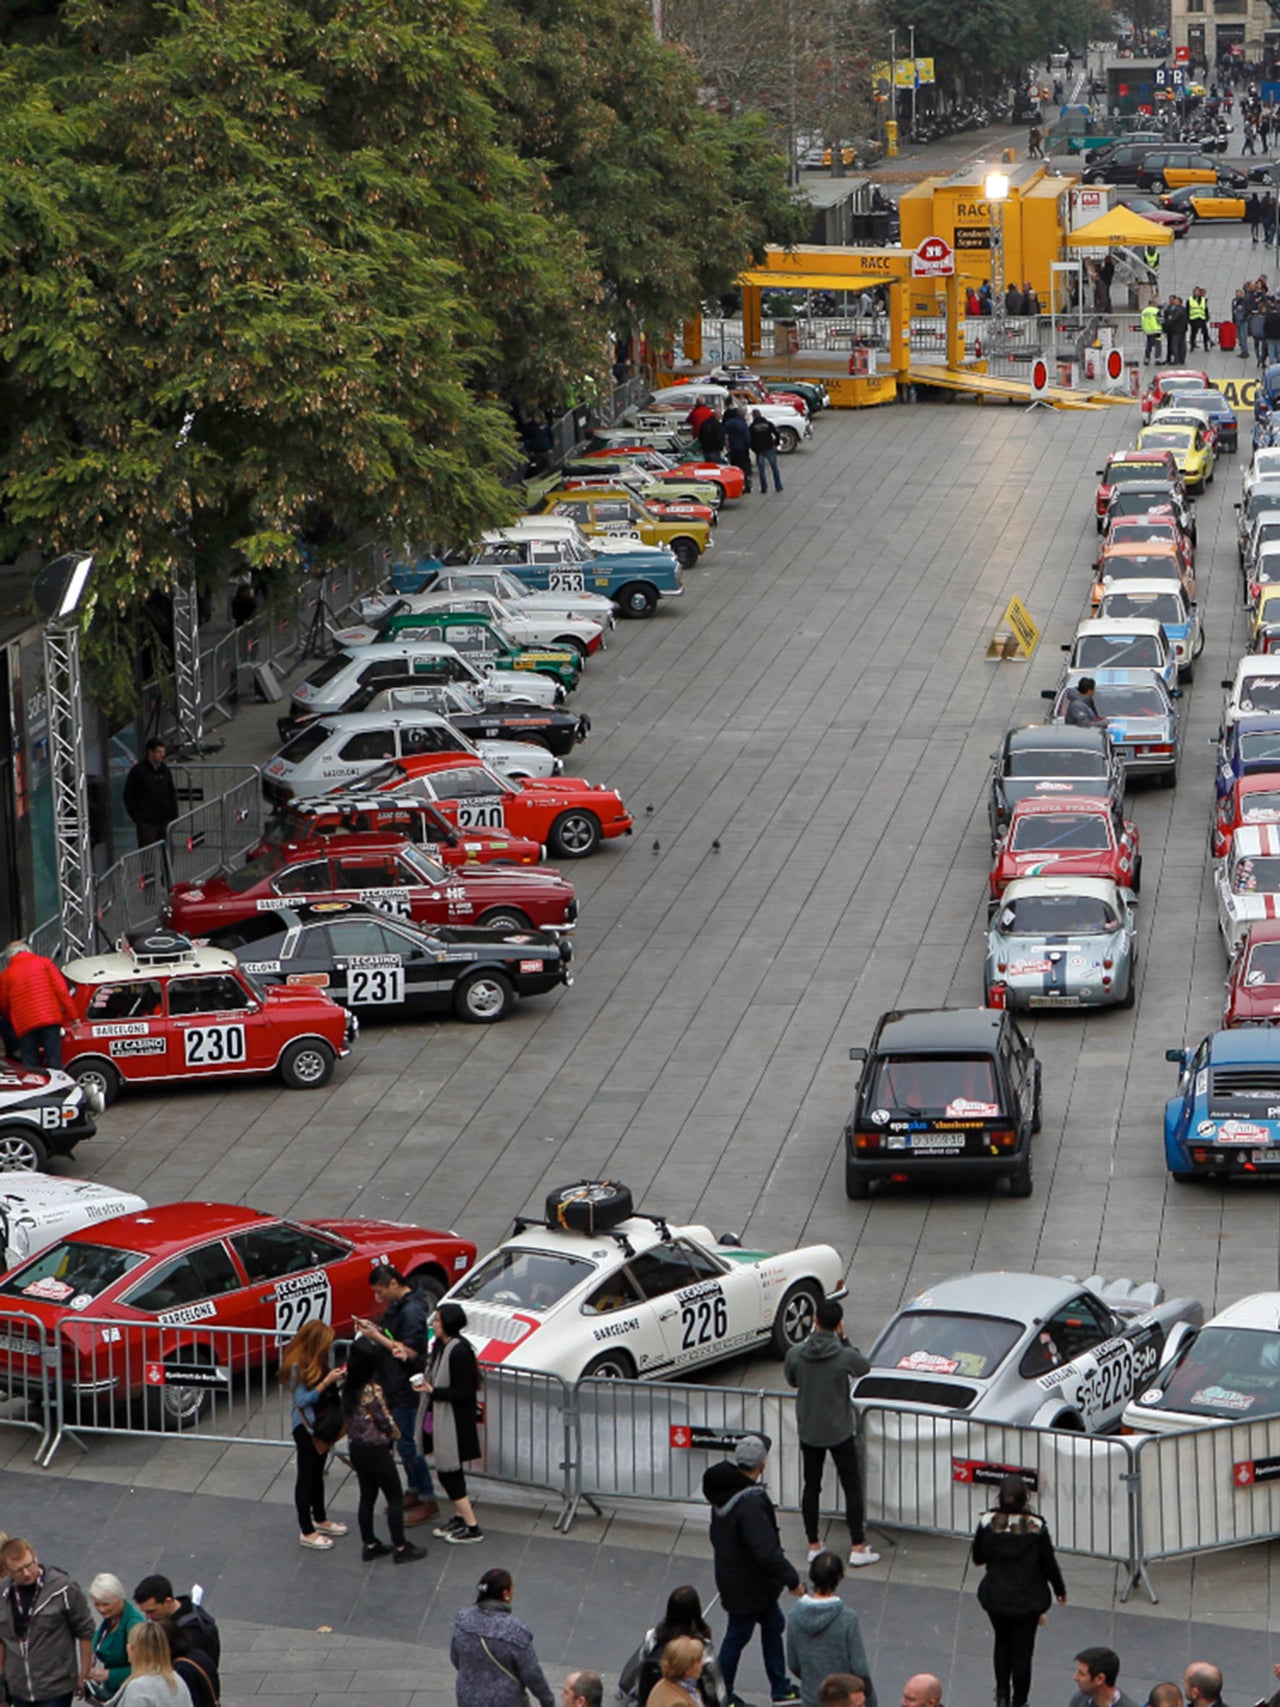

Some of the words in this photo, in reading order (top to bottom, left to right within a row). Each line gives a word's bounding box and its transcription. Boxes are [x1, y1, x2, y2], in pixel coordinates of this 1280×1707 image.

[957, 204, 991, 216] RAC
[861, 258, 890, 268] RACC
[551, 575, 584, 592] 253
[460, 808, 503, 828] 240
[352, 970, 399, 1001] 231
[188, 1027, 244, 1062] 230
[43, 1107, 78, 1128] BP
[162, 1303, 213, 1324] BARCELONE
[279, 1291, 327, 1343] 227
[682, 1297, 728, 1350] 226
[593, 1318, 641, 1341] BARCELONE
[1102, 1353, 1132, 1410] 223
